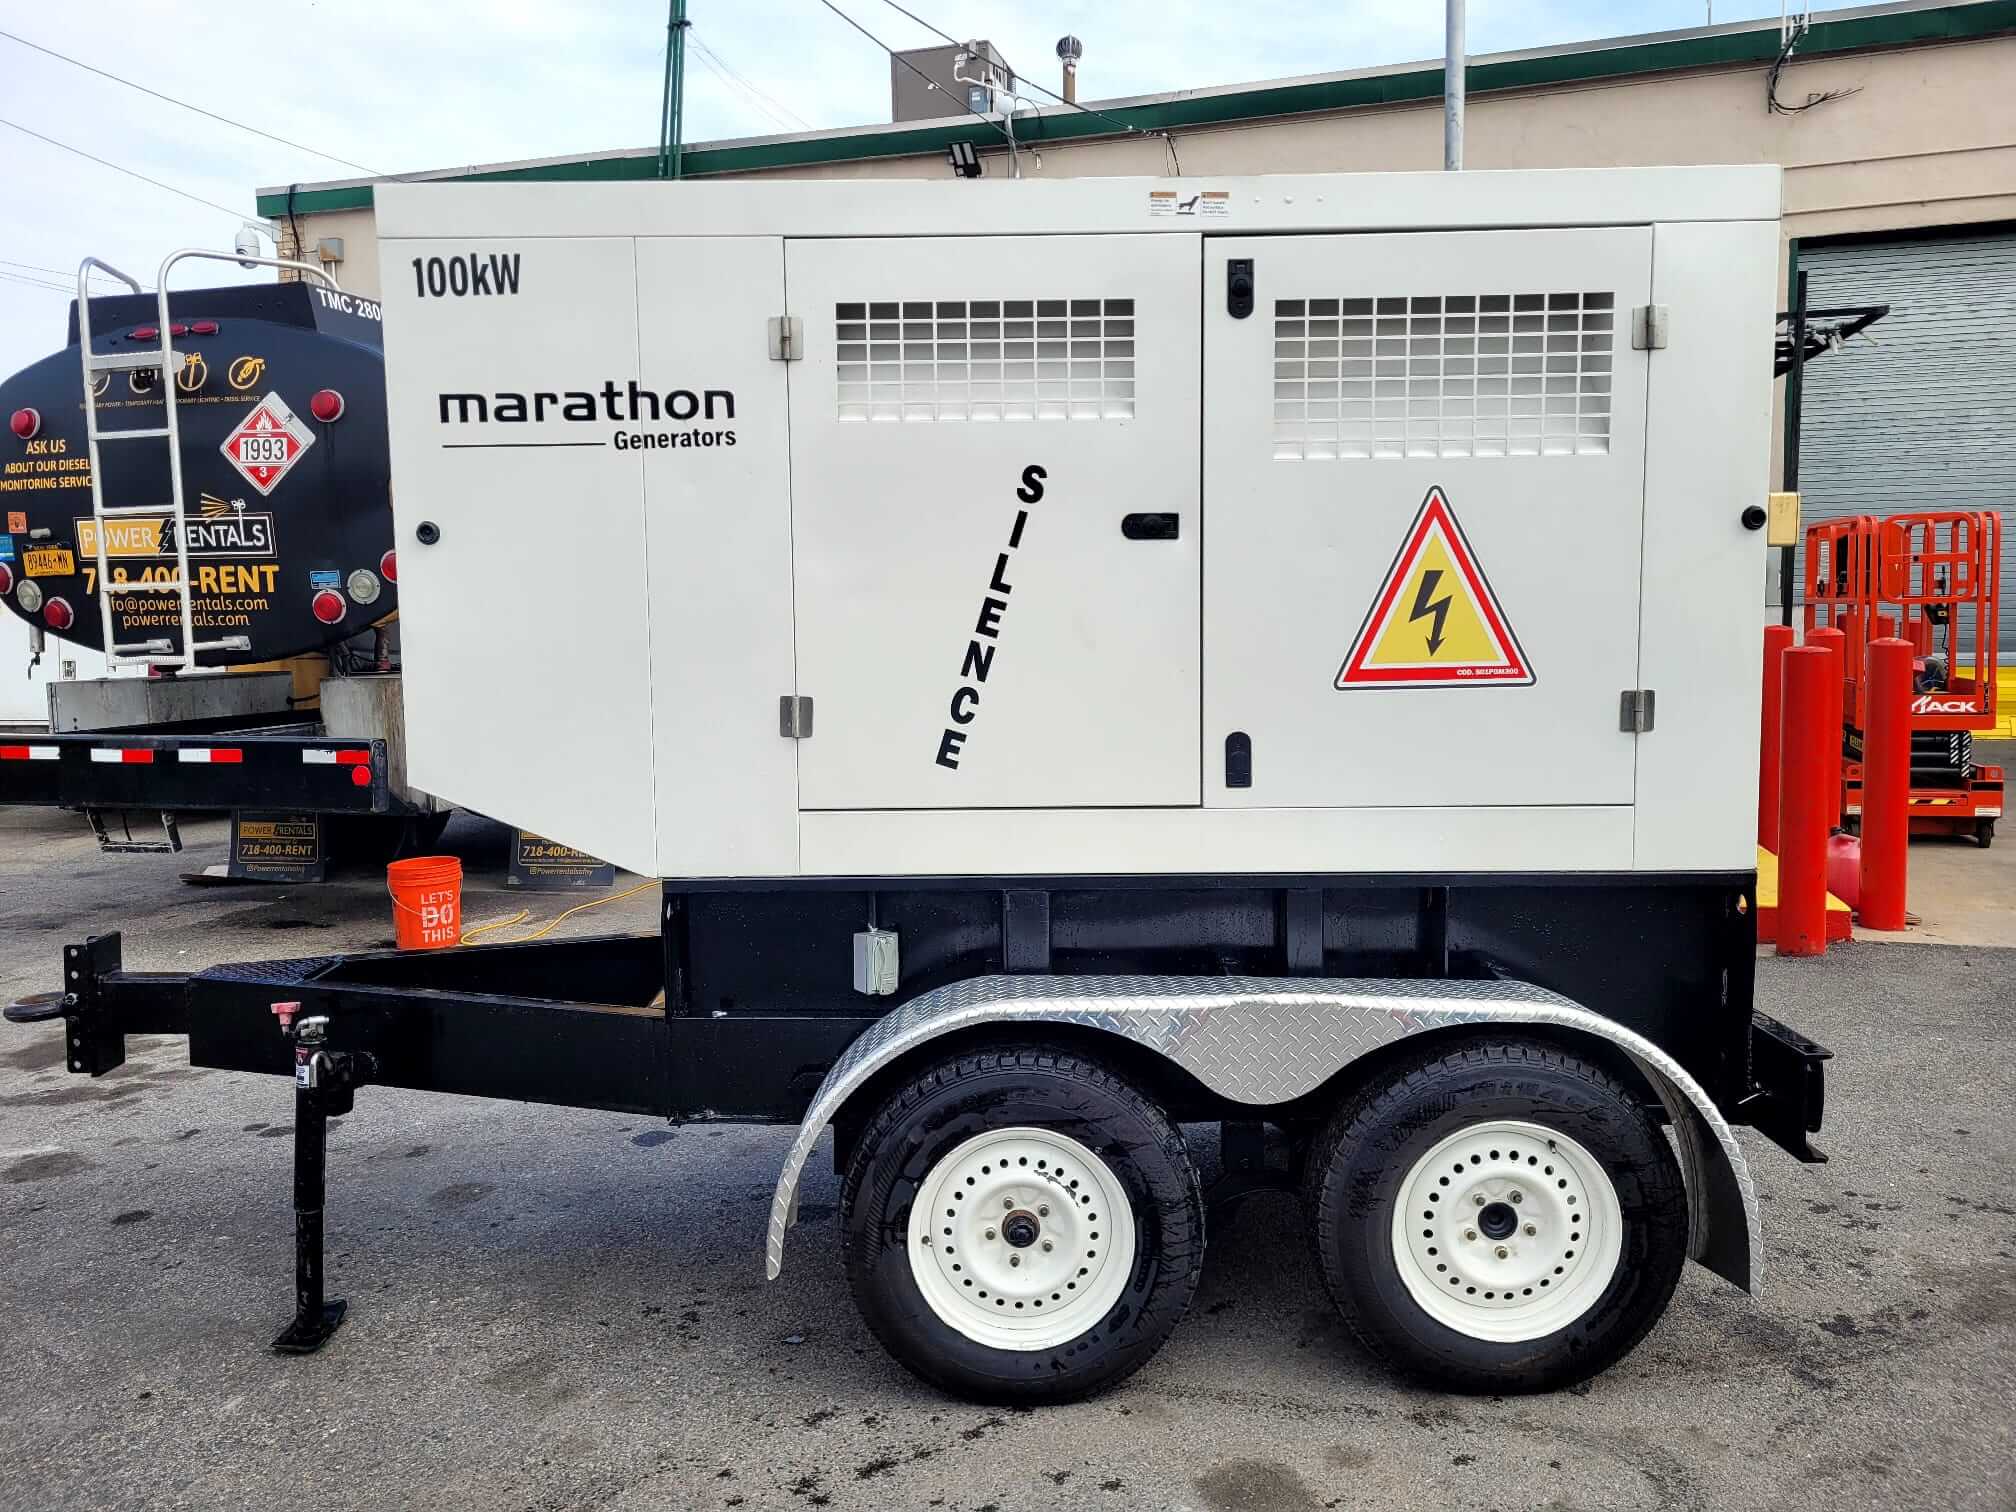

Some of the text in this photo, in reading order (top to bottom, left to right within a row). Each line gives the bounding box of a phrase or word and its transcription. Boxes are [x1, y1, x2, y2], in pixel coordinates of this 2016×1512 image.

[412, 253, 521, 298] 100kW
[316, 288, 384, 321] TMC 280
[438, 380, 736, 423] marathon
[25, 440, 66, 455] ASK US
[243, 438, 285, 461] 1993
[613, 428, 738, 450] Generators
[5, 458, 91, 474] ABOUT OUR DIESEL
[259, 466, 268, 478] 3
[0, 475, 95, 492] MONITORING SERVIC
[174, 524, 265, 547] ENTALS
[936, 464, 1048, 770] SILENCE
[243, 824, 313, 835] POWER RENTALS
[241, 844, 313, 856] 718-400-RENT
[421, 890, 454, 905] LET'S
[421, 903, 454, 929] DO
